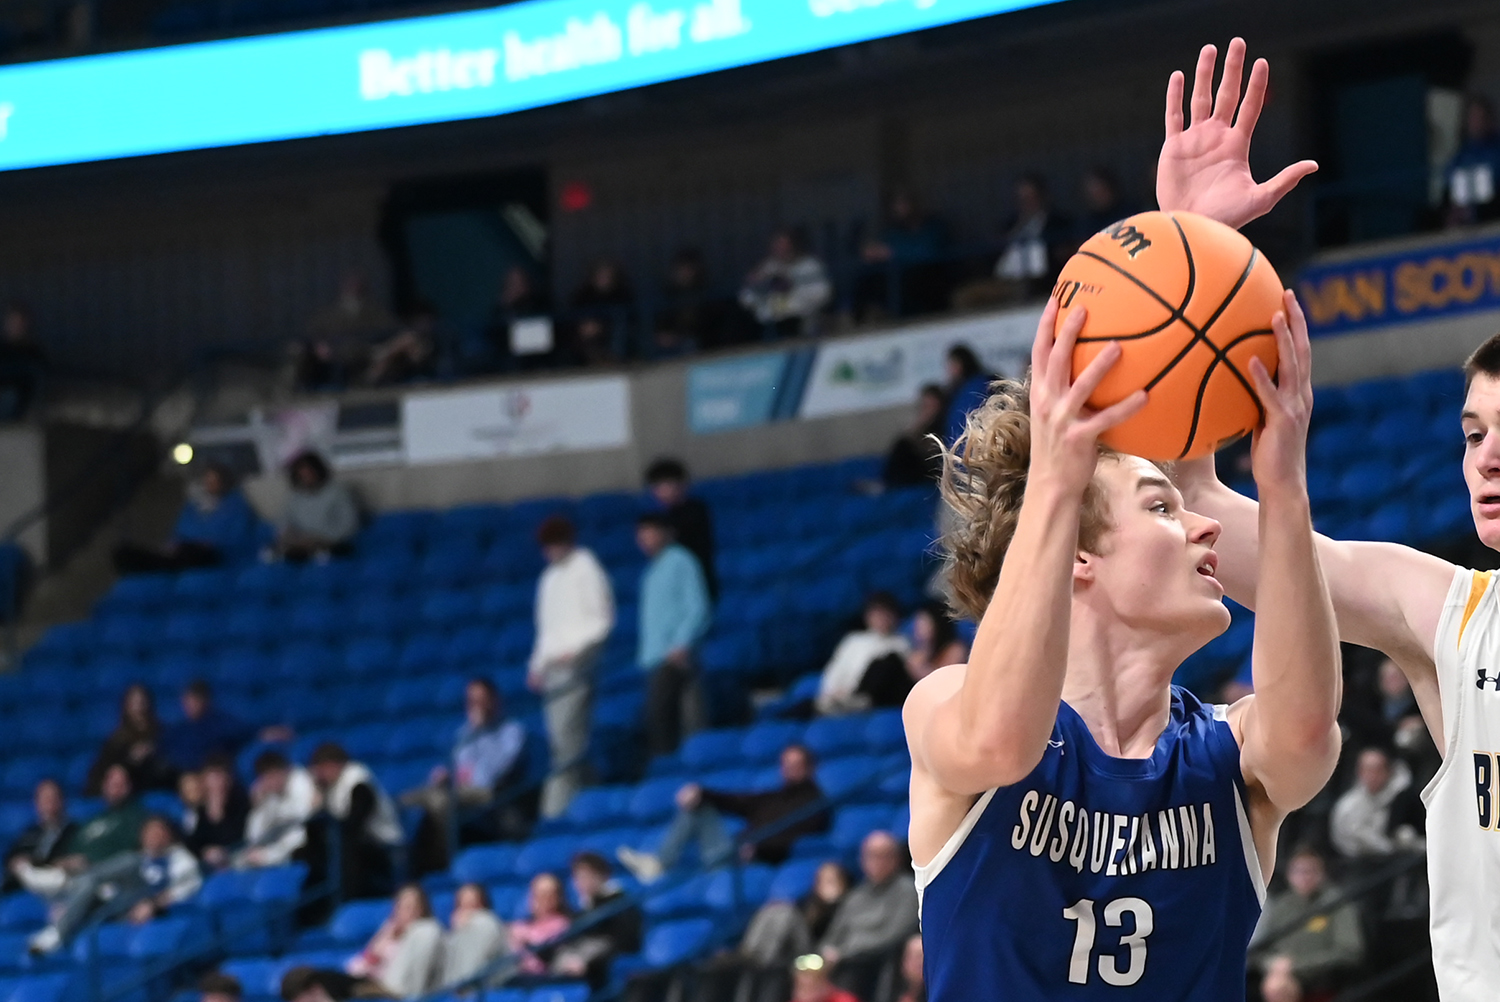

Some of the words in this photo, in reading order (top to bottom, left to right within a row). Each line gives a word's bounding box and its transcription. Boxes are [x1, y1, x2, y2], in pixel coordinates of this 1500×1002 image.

[359, 49, 499, 99] Better
[627, 4, 684, 56] for
[1302, 268, 1385, 327] VAN
[1063, 897, 1154, 987] 13
